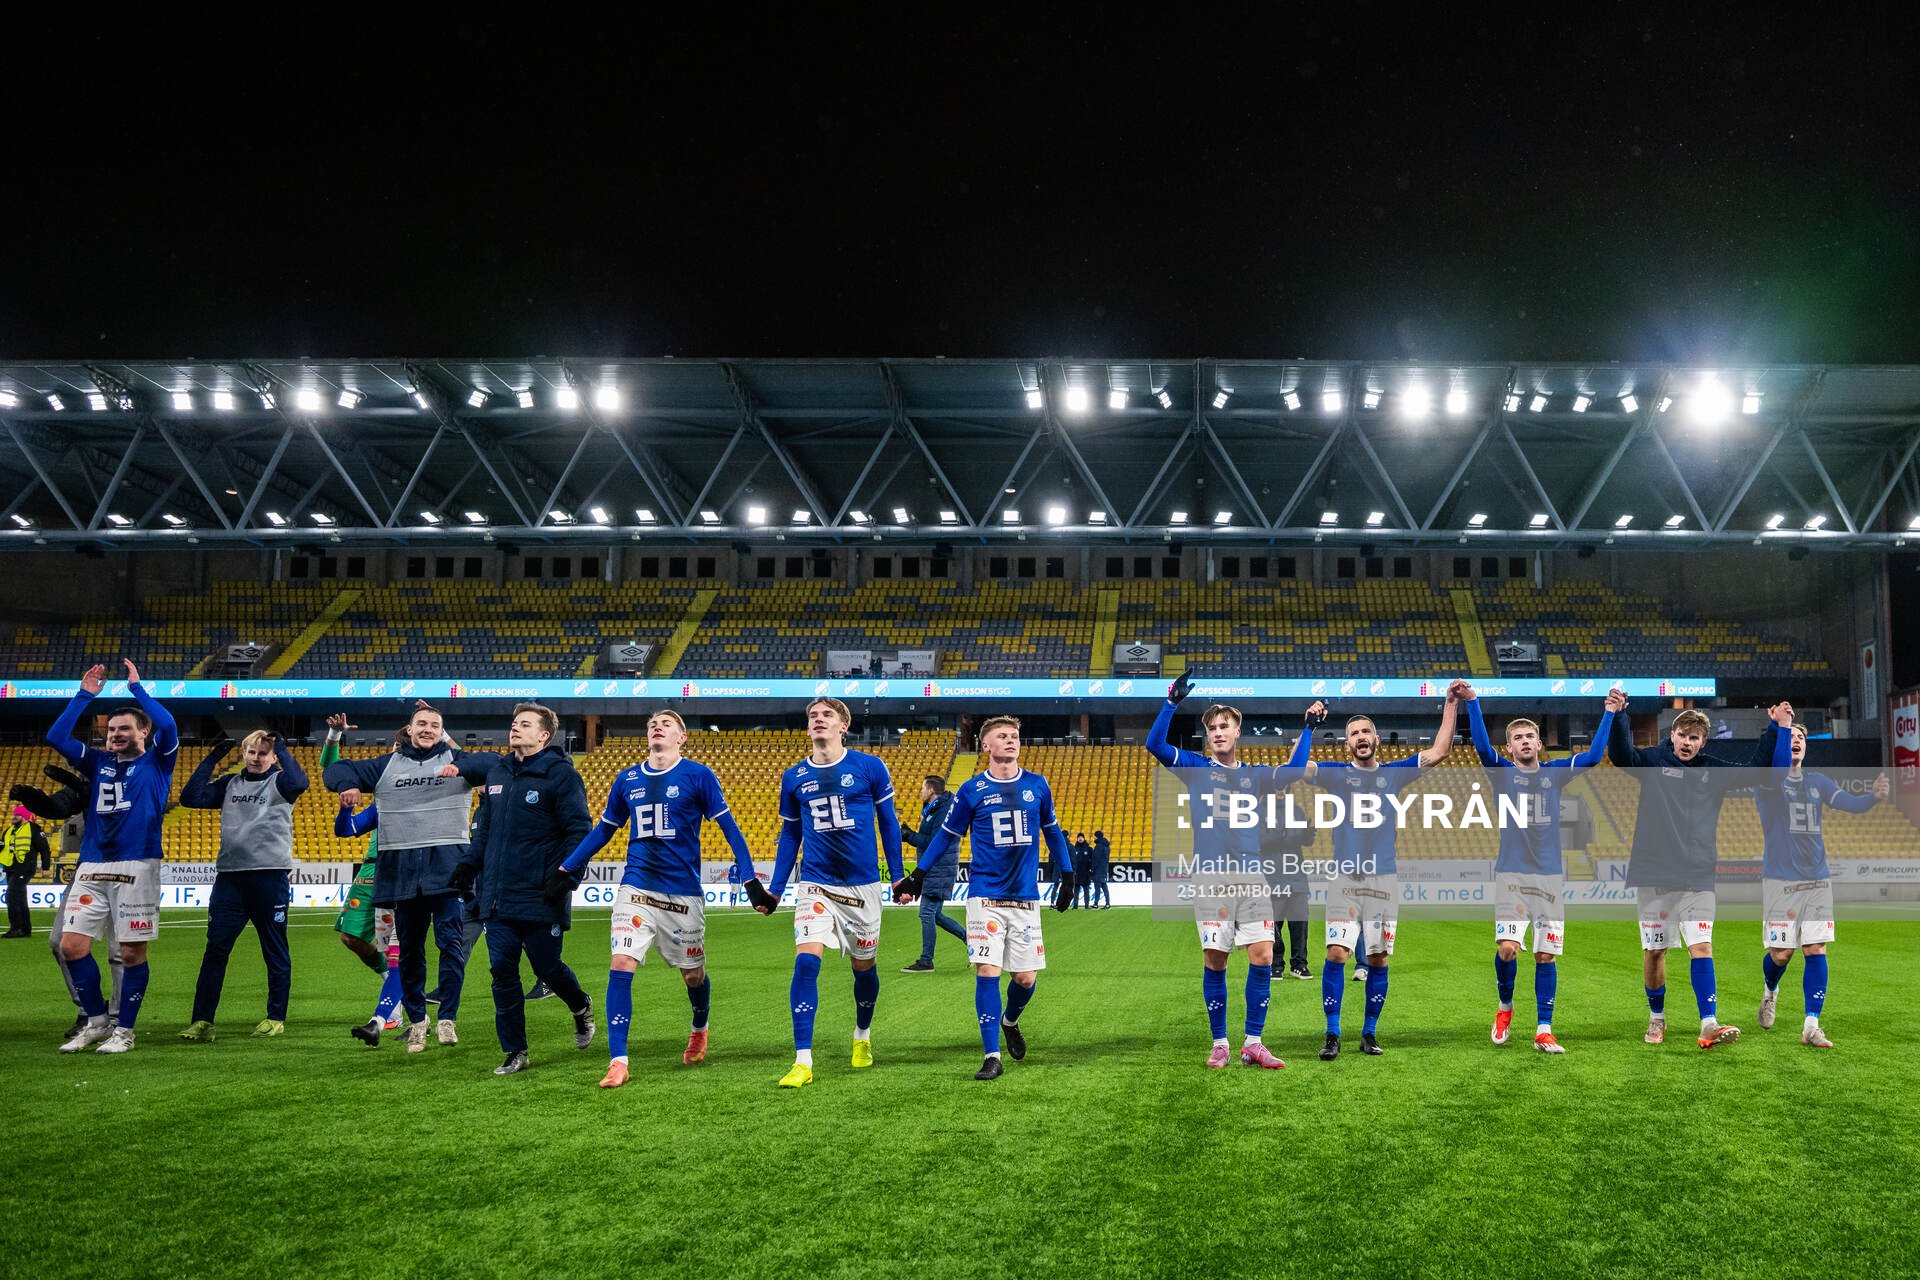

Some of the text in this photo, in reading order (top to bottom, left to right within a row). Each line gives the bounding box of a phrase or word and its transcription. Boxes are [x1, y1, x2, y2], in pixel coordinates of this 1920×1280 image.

[20, 688, 64, 697] OLOFSSON
[240, 688, 309, 697] OLOFSSON BYGG
[469, 688, 538, 696] OLOFSSON BYGG
[702, 688, 770, 696] OLOFSSON BYGG
[943, 687, 1011, 696] OLOFSSON BYGG
[1190, 687, 1255, 695] LOFSSON BYGG
[1483, 687, 1507, 695] BYGG
[395, 777, 434, 787] CRAFT
[232, 795, 259, 804] CRAFT
[809, 795, 855, 831] EL
[1789, 802, 1820, 832] EL
[635, 803, 675, 838] EL
[991, 810, 1032, 845] EL
[172, 866, 218, 874] KNALLEN
[1112, 865, 1152, 882] Stn.
[1872, 866, 1920, 874] MERCURY
[290, 868, 339, 884] dwall
[176, 887, 200, 906] IF,
[584, 886, 614, 903] Gö
[1403, 883, 1427, 900] åk
[1438, 885, 1484, 900] med
[632, 895, 645, 905] XL
[803, 925, 809, 936] 3
[1508, 923, 1517, 934] 19
[624, 937, 633, 948] 10
[1654, 932, 1664, 943] 25
[1781, 932, 1787, 942] 8
[978, 945, 990, 957] 22
